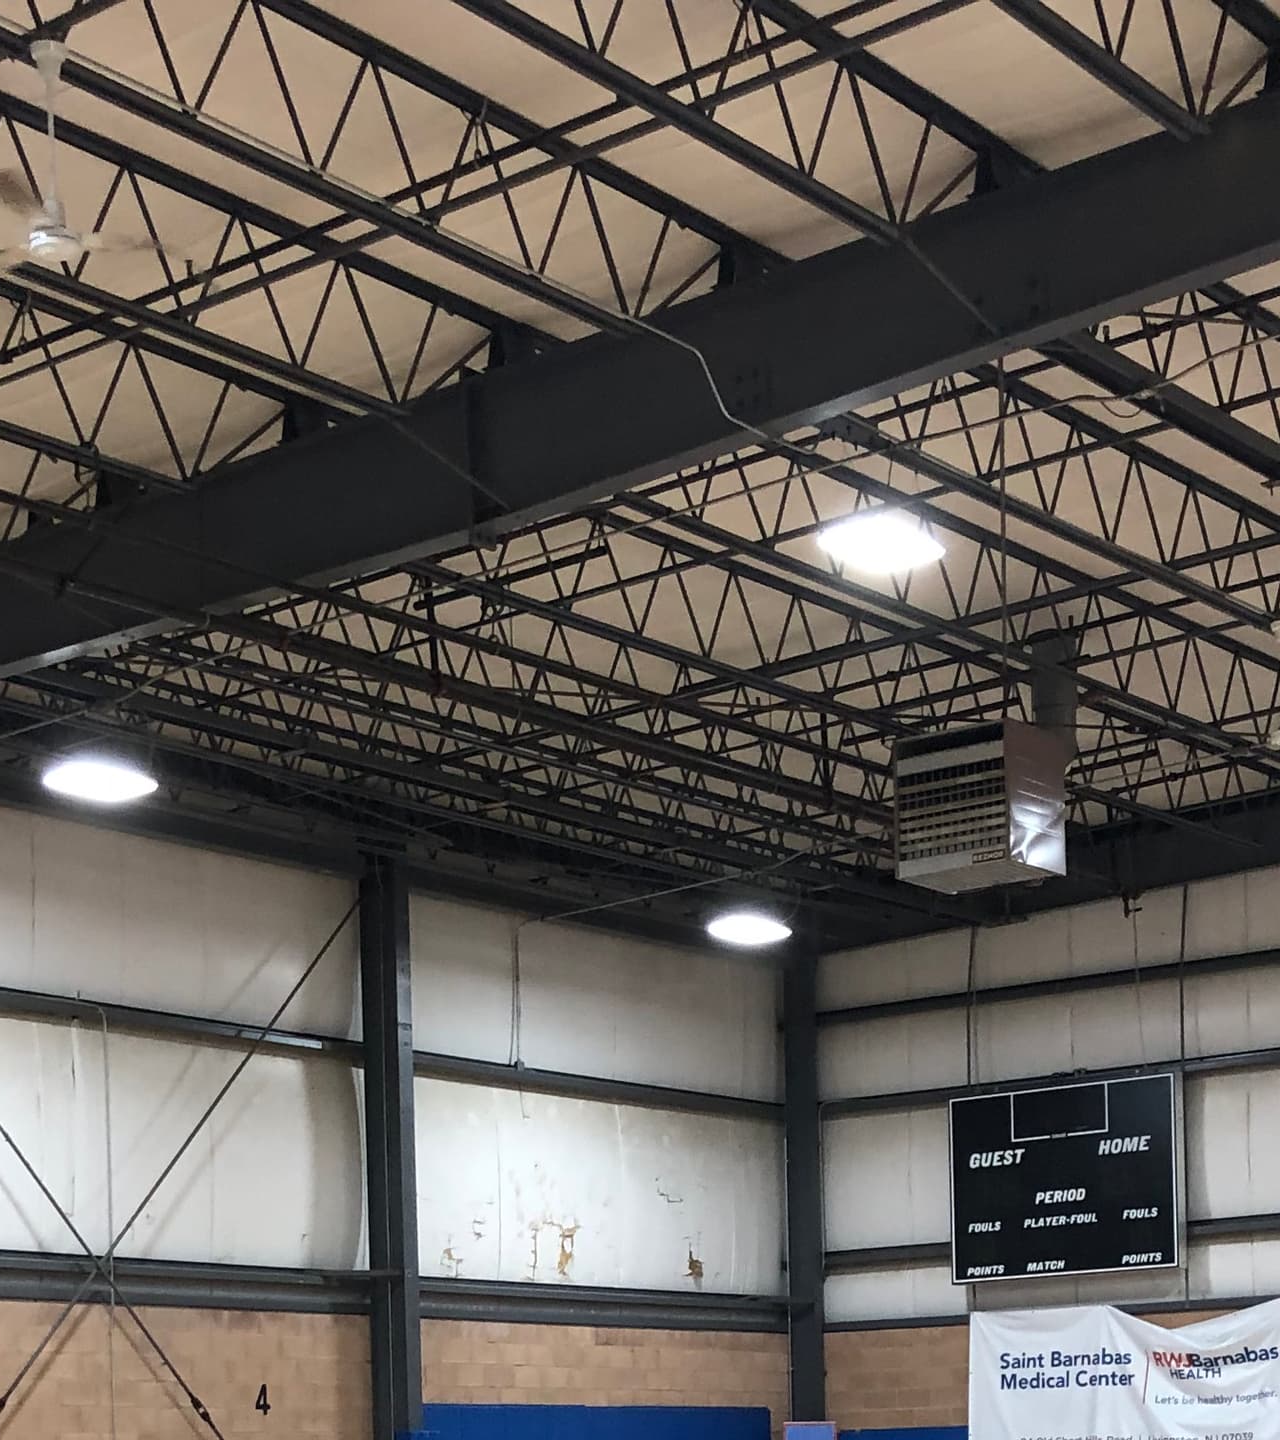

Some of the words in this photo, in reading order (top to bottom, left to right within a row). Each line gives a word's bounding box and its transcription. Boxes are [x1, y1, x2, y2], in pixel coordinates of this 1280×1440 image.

[1098, 1135, 1152, 1156] HOME
[969, 1148, 1026, 1169] GUEST
[1035, 1188, 1086, 1205] PERIOD
[1122, 1207, 1159, 1220] FOULS
[968, 1221, 1002, 1233] FOULS
[1024, 1213, 1098, 1229] PLAYER-FOUL
[1122, 1252, 1162, 1264] POINTS
[967, 1265, 1005, 1277] POINTS
[1027, 1260, 1066, 1272] MATCH
[1000, 1352, 1045, 1370] Saint
[1051, 1347, 1132, 1368] Barnabas
[1000, 1371, 1070, 1391] Medical
[1075, 1370, 1135, 1388] Center
[1170, 1367, 1222, 1380] HEALTH
[255, 1383, 271, 1416] 4
[1155, 1394, 1179, 1405] Let's
[1182, 1396, 1195, 1405] be
[1198, 1394, 1233, 1406] healthy
